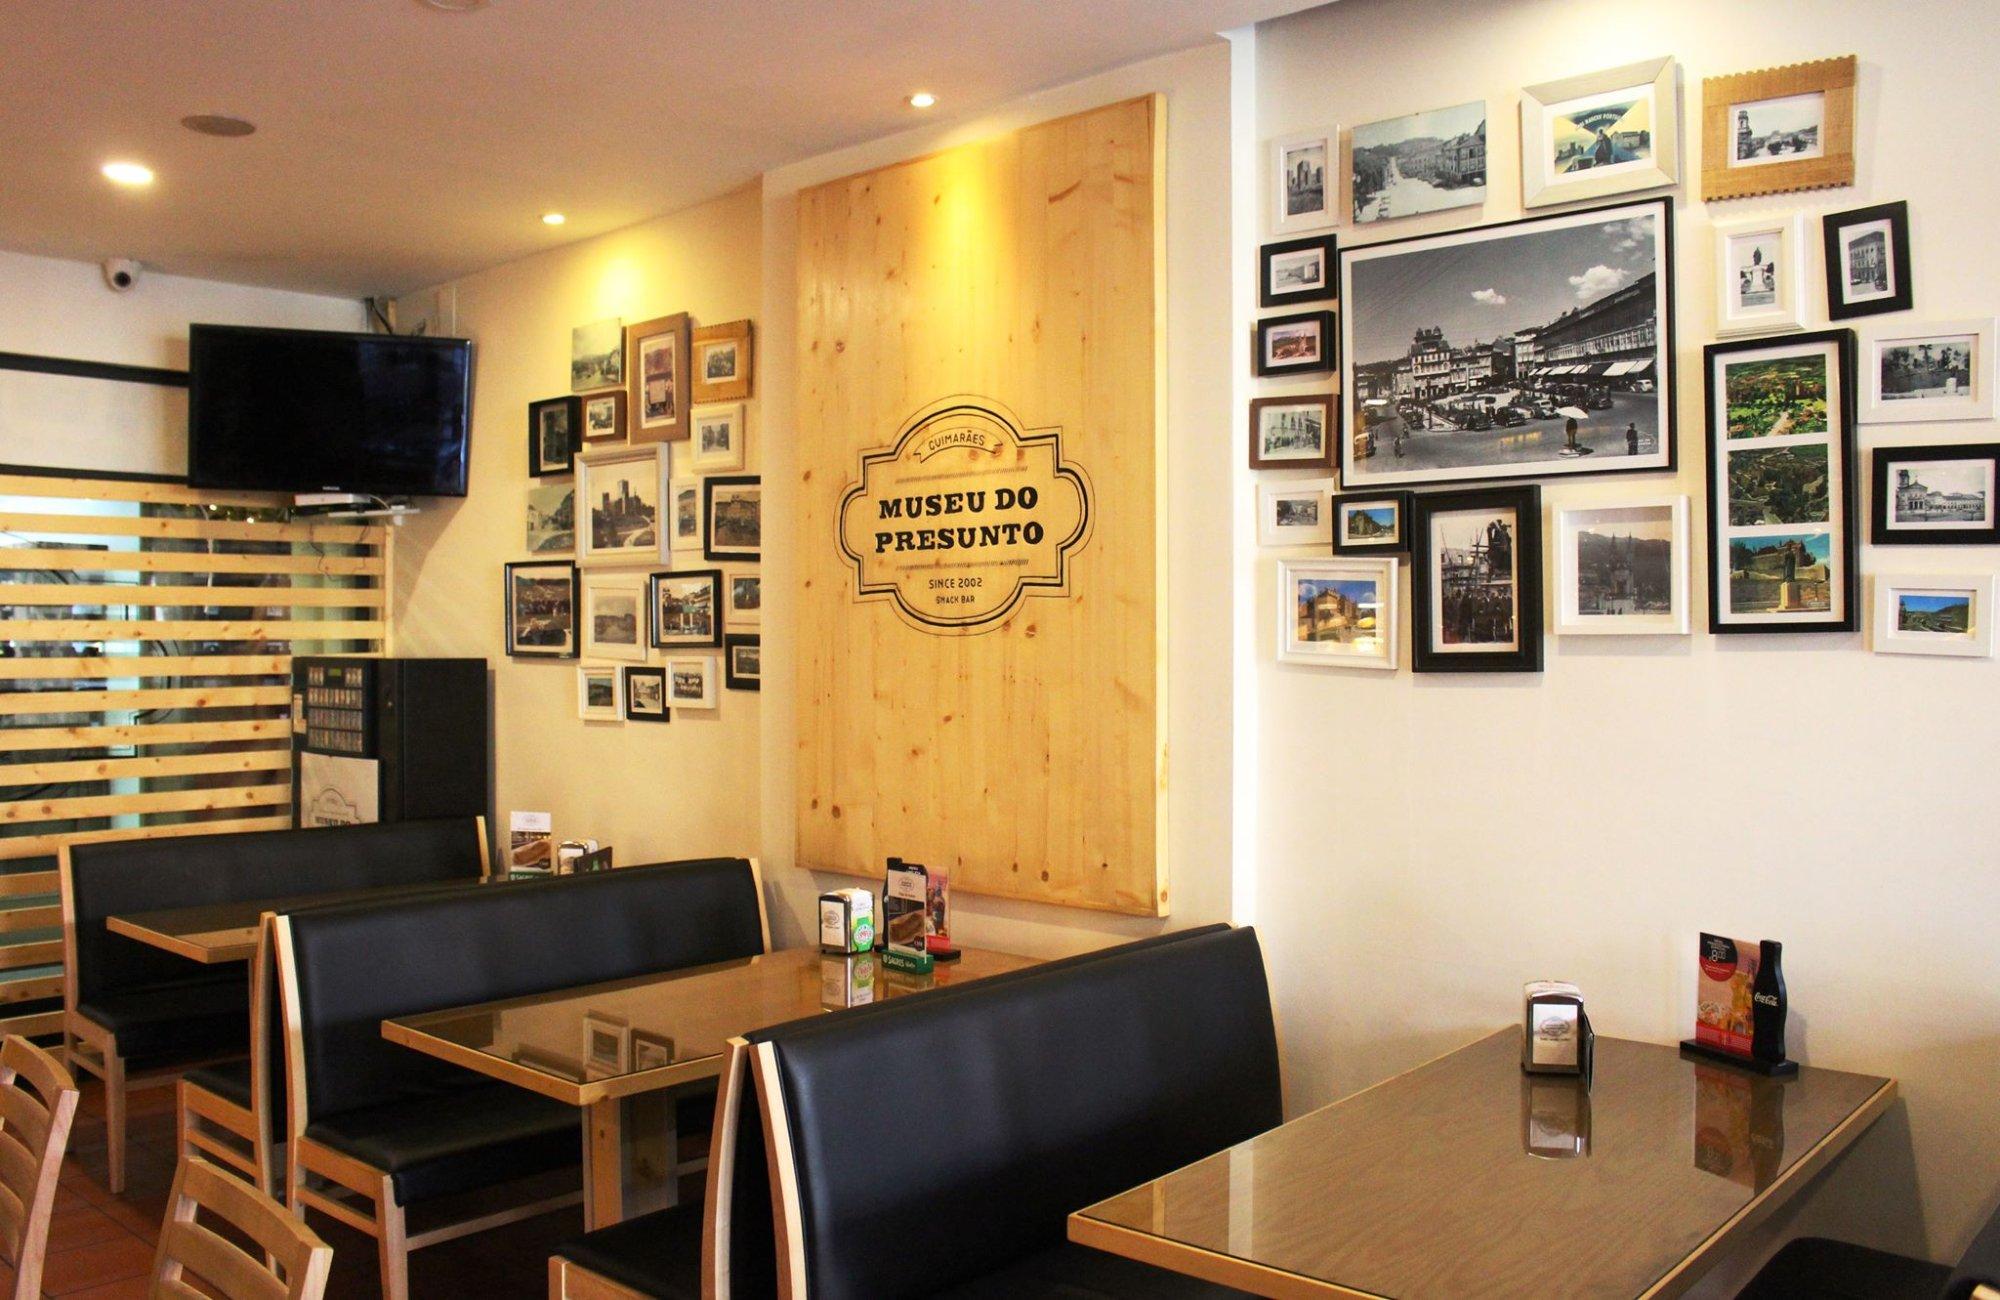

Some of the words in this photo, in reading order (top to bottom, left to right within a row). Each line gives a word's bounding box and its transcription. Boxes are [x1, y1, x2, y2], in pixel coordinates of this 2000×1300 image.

[928, 430, 986, 451] GUIMARÃES
[878, 490, 986, 520] MUSEU
[994, 486, 1039, 511] DO
[874, 521, 1044, 554] PRESUNTO
[928, 578, 955, 590] SINCE
[958, 577, 983, 589] 2002
[935, 596, 959, 605] SNACK
[961, 595, 976, 605] BAR
